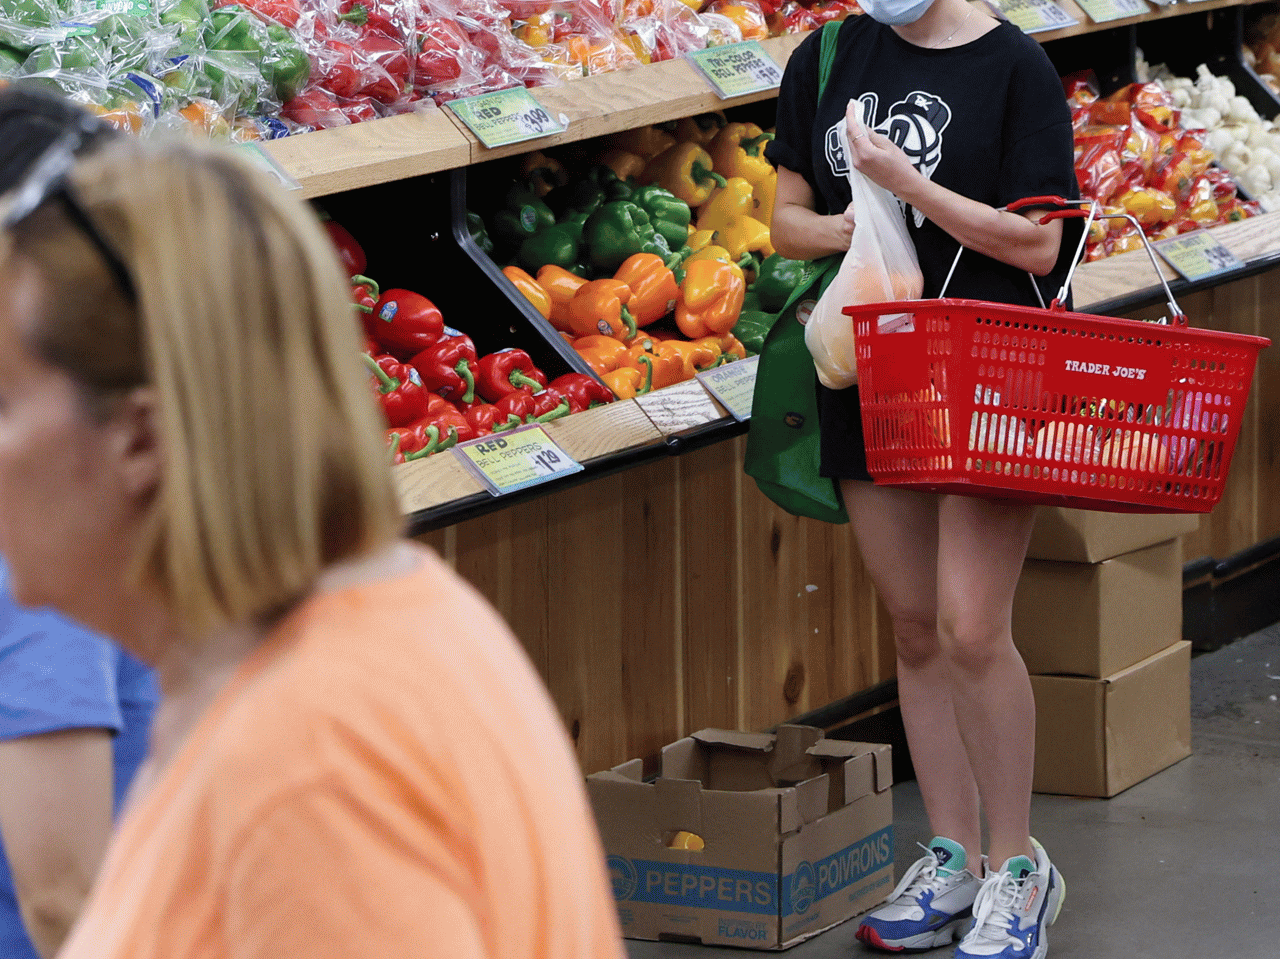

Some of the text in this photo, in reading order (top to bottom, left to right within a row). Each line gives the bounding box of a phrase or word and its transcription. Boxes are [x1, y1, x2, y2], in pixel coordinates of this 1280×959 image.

[706, 50, 756, 69] TRI-COLOR
[732, 58, 766, 75] PEPPERS
[711, 67, 735, 79] BELL
[473, 106, 502, 121] RED
[474, 122, 494, 132] BELL
[712, 365, 748, 383] ORANGE
[1064, 359, 1148, 381] TRADER JOE'S
[476, 438, 508, 456] RED
[476, 442, 542, 469] BELL PEPPERS
[819, 833, 890, 893] POIVRONS
[645, 870, 772, 906] PEPPERS
[718, 925, 768, 941] FLAVOR
